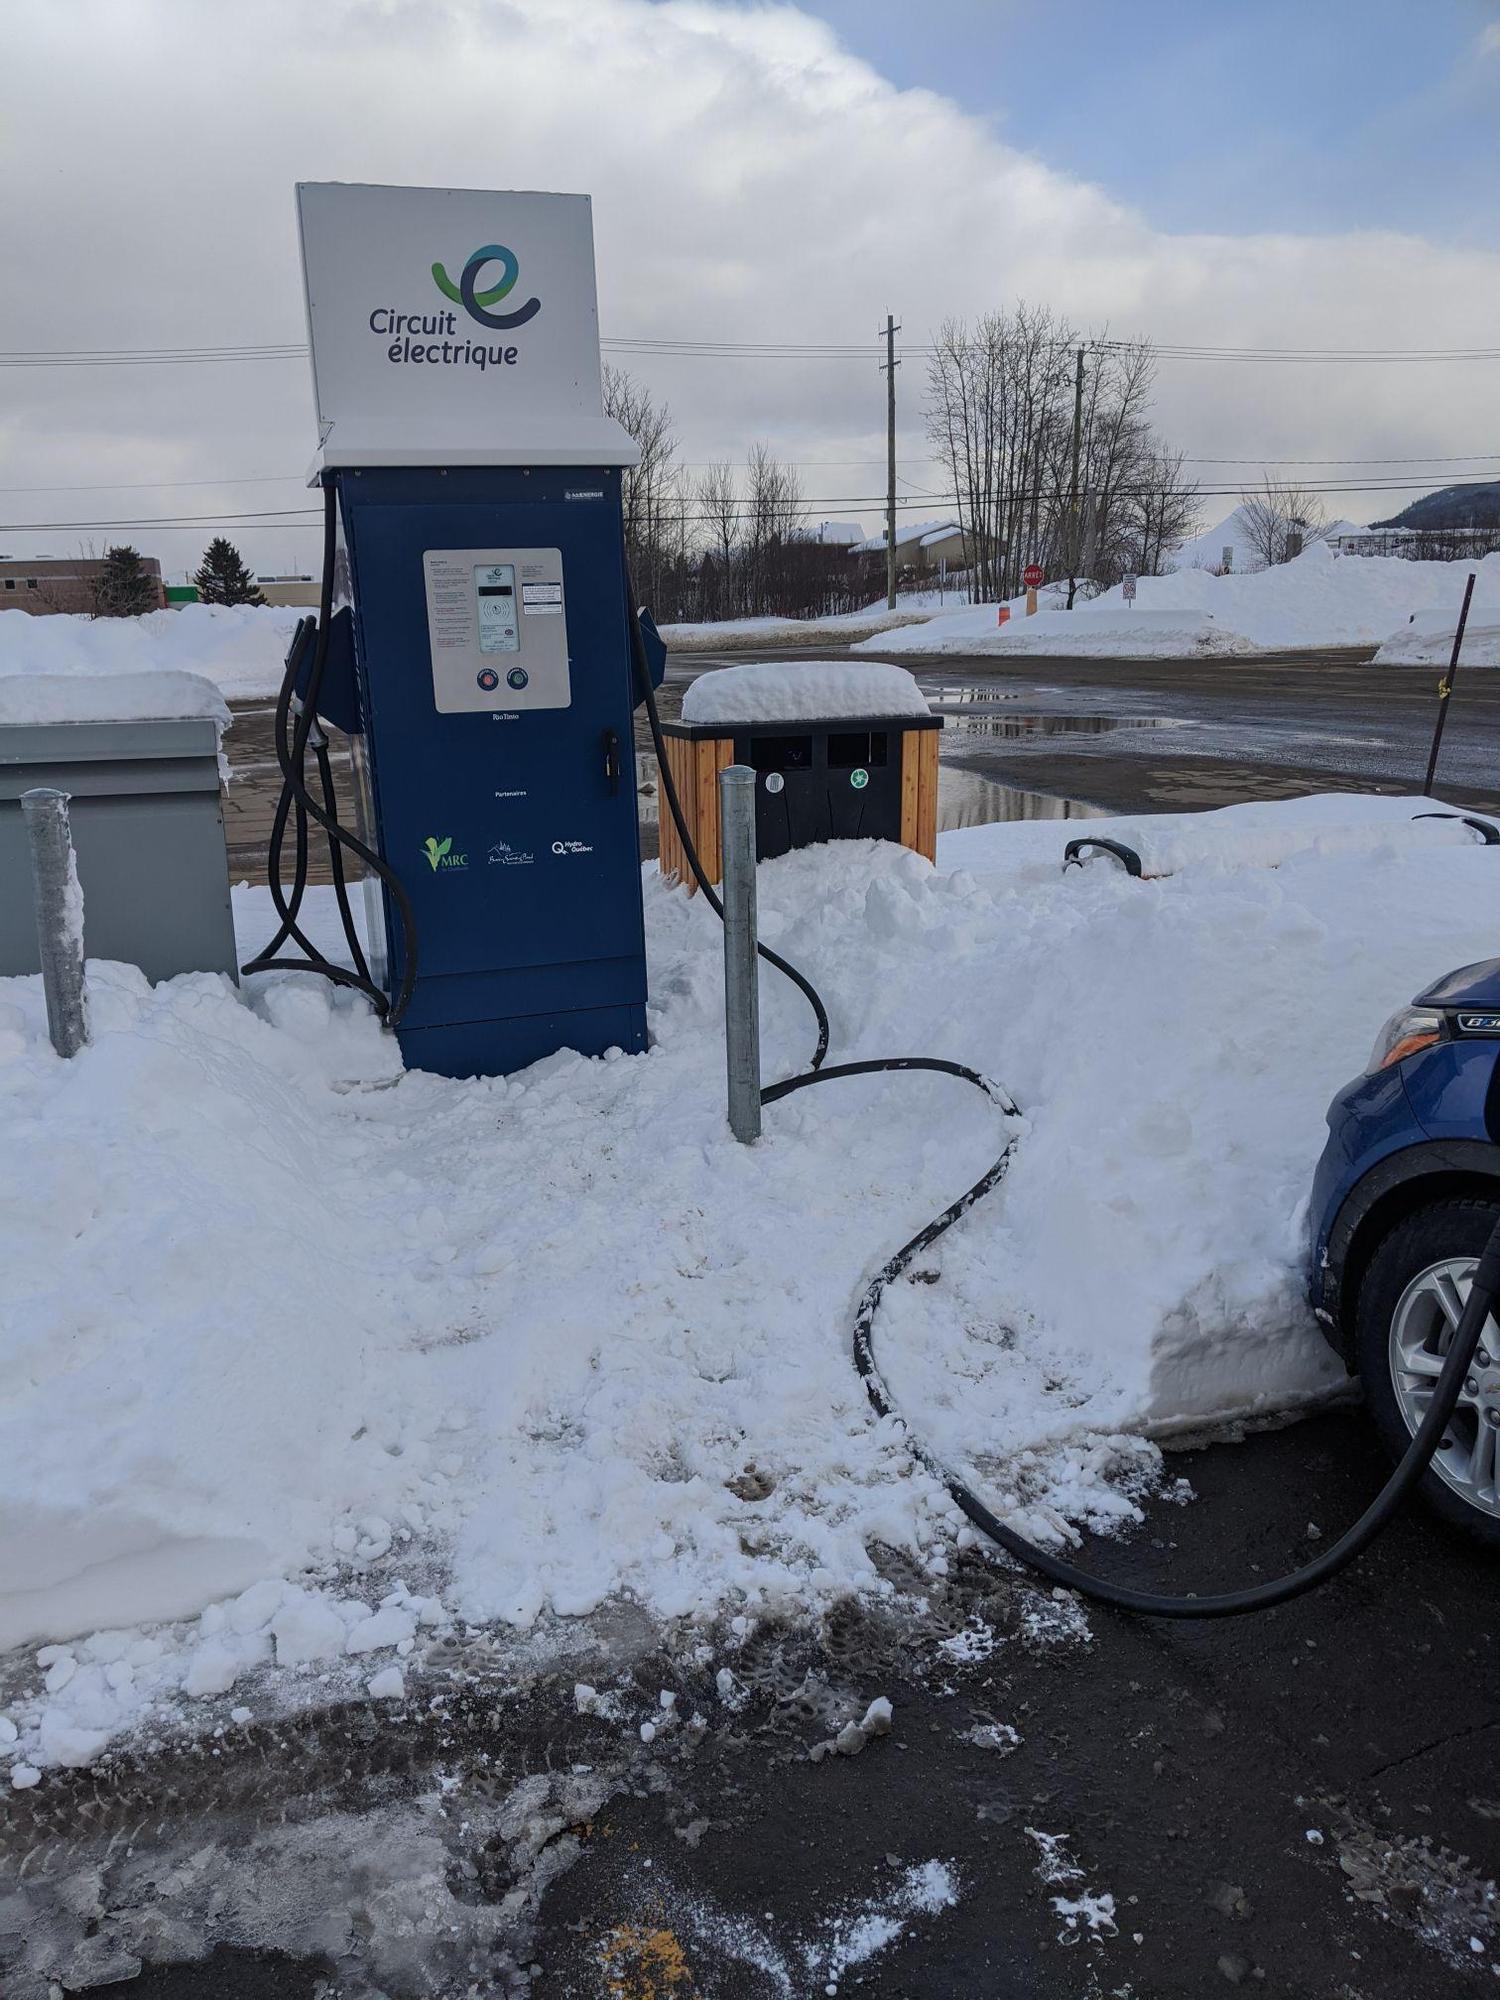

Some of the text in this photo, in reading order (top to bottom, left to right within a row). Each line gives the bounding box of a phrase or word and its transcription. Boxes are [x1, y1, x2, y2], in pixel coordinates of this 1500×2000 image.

[369, 308, 457, 336] Circuit
[387, 336, 518, 371] électrique
[492, 713, 504, 721] Rio
[564, 840, 583, 848] Hydro
[441, 853, 469, 867] MRC
